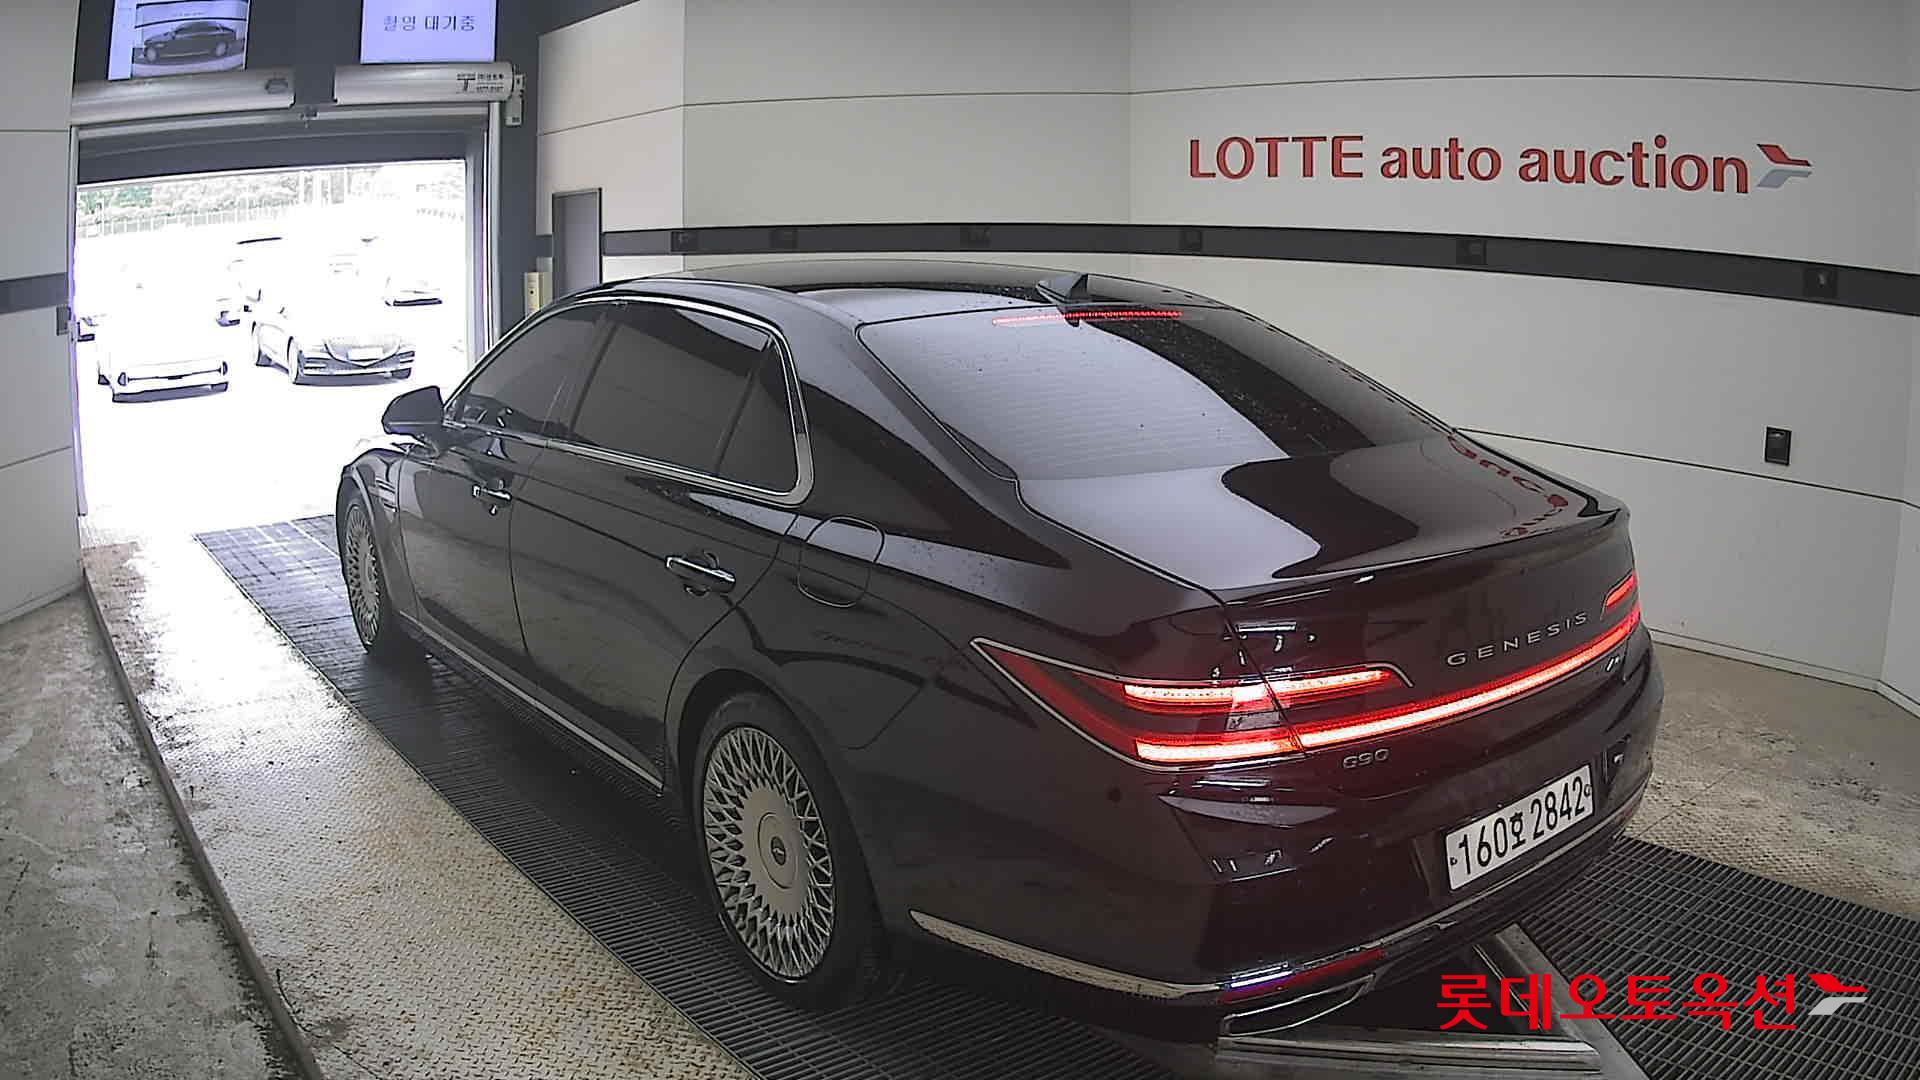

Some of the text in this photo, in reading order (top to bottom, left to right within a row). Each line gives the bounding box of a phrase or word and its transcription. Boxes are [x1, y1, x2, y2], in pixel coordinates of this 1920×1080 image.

[424, 15, 477, 32] 대기중
[1189, 134, 1749, 194] LOTTE auto auction
[1447, 611, 1587, 666] GENESIS
[1342, 748, 1390, 769] G90
